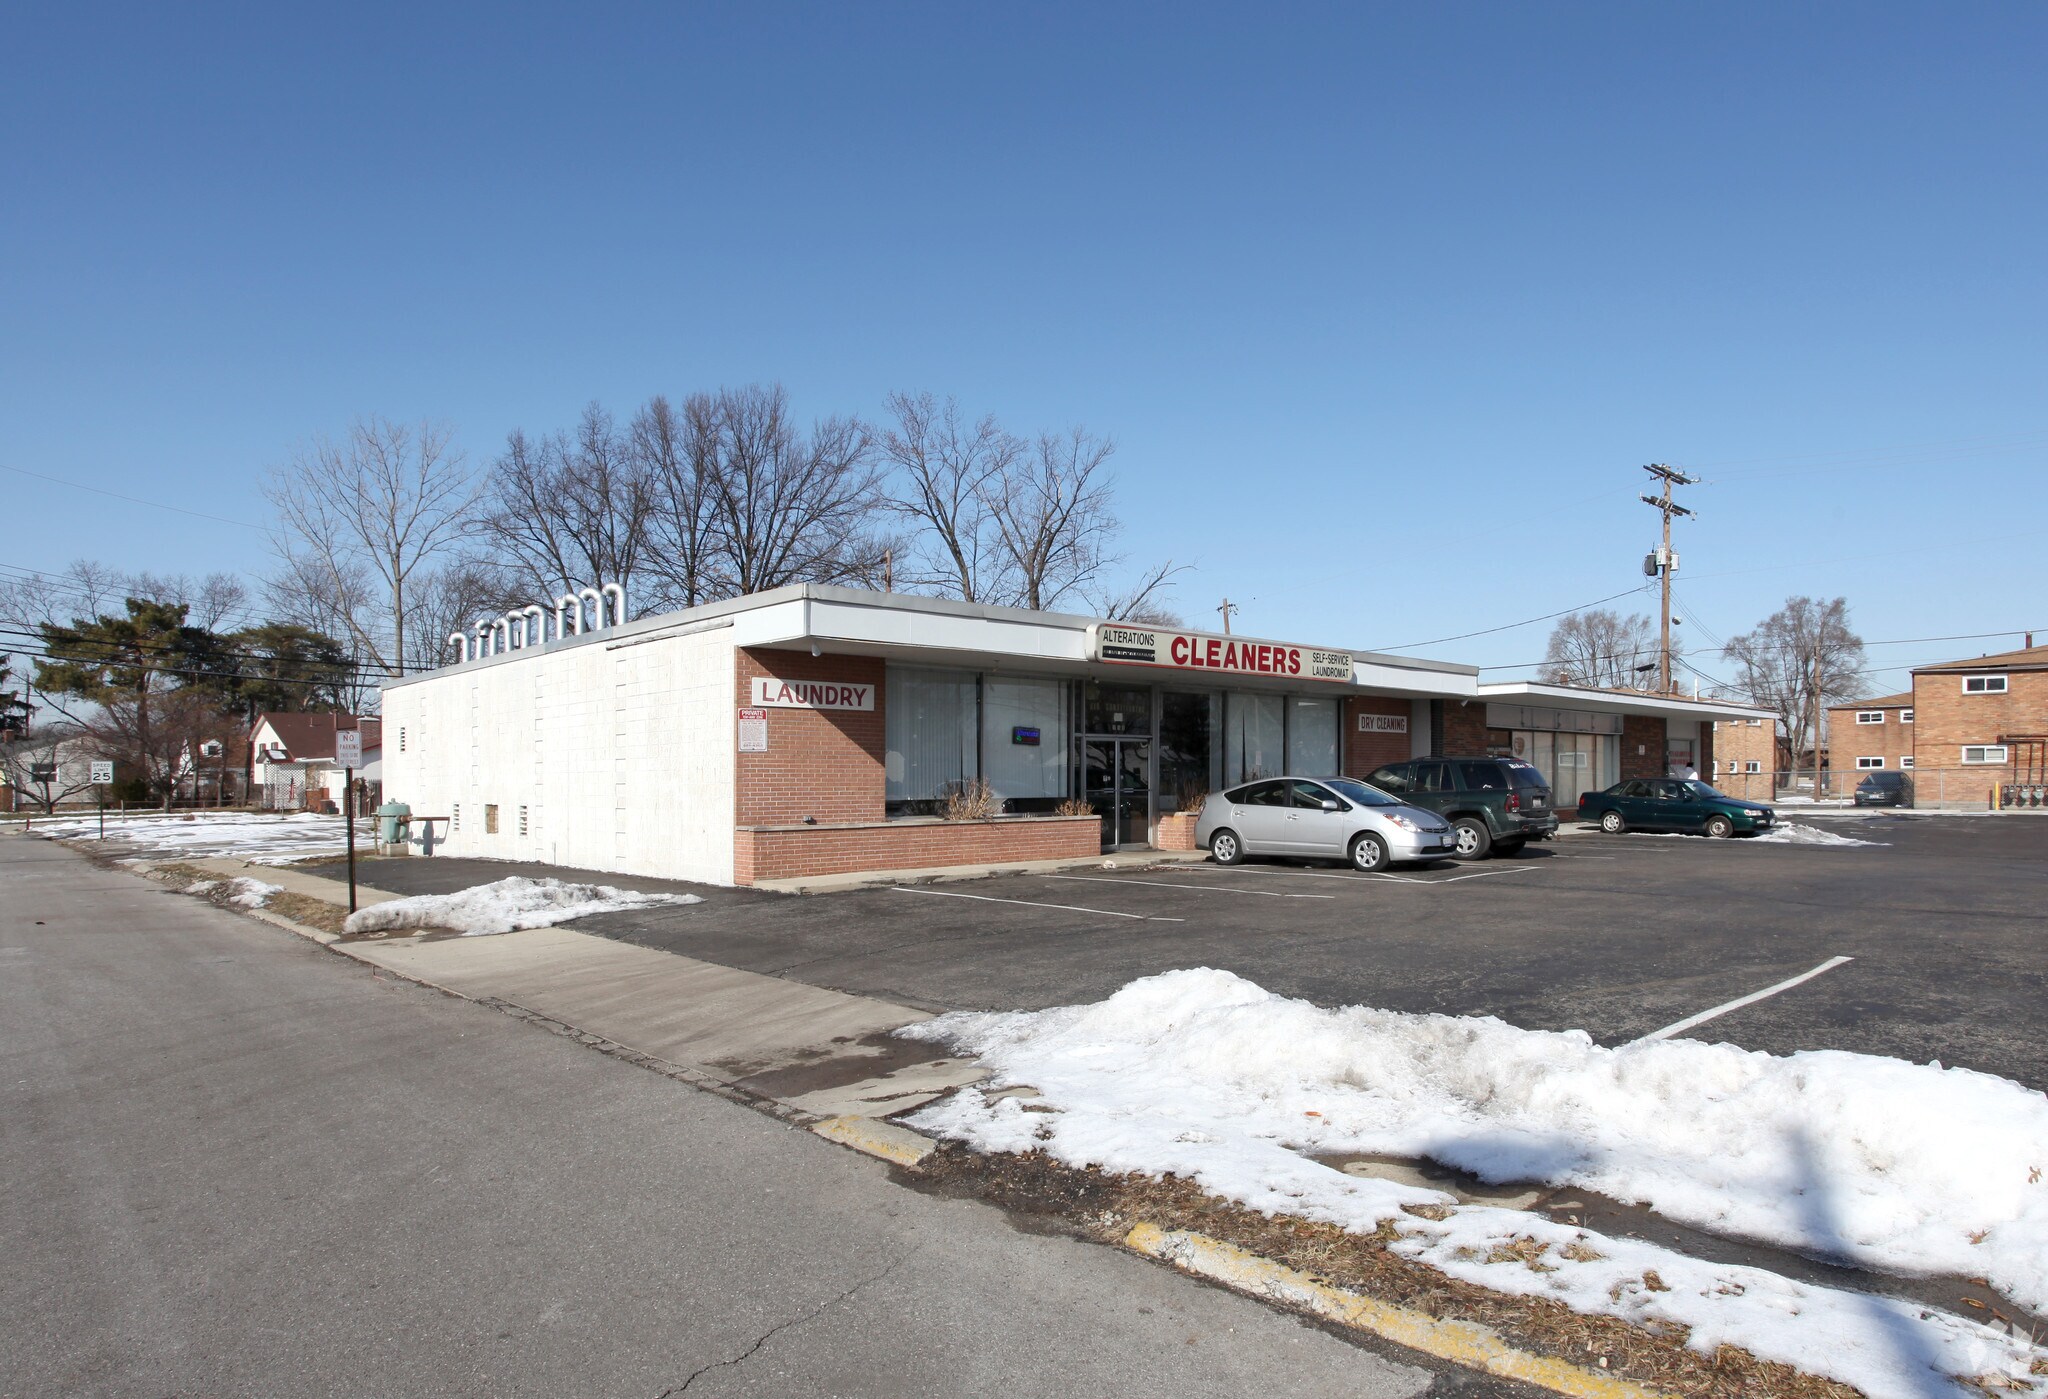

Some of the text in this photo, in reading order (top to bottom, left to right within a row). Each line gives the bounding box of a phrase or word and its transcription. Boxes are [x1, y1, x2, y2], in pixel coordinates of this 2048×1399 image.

[1103, 630, 1155, 646] ALTERATIONS
[1171, 636, 1301, 675] CLEANERS
[1312, 652, 1349, 666] SELF-SERVICE
[1312, 666, 1349, 678] LAUNDROMAT
[762, 681, 868, 707] LAUNDRY
[1361, 716, 1405, 731] DRY CLEANING
